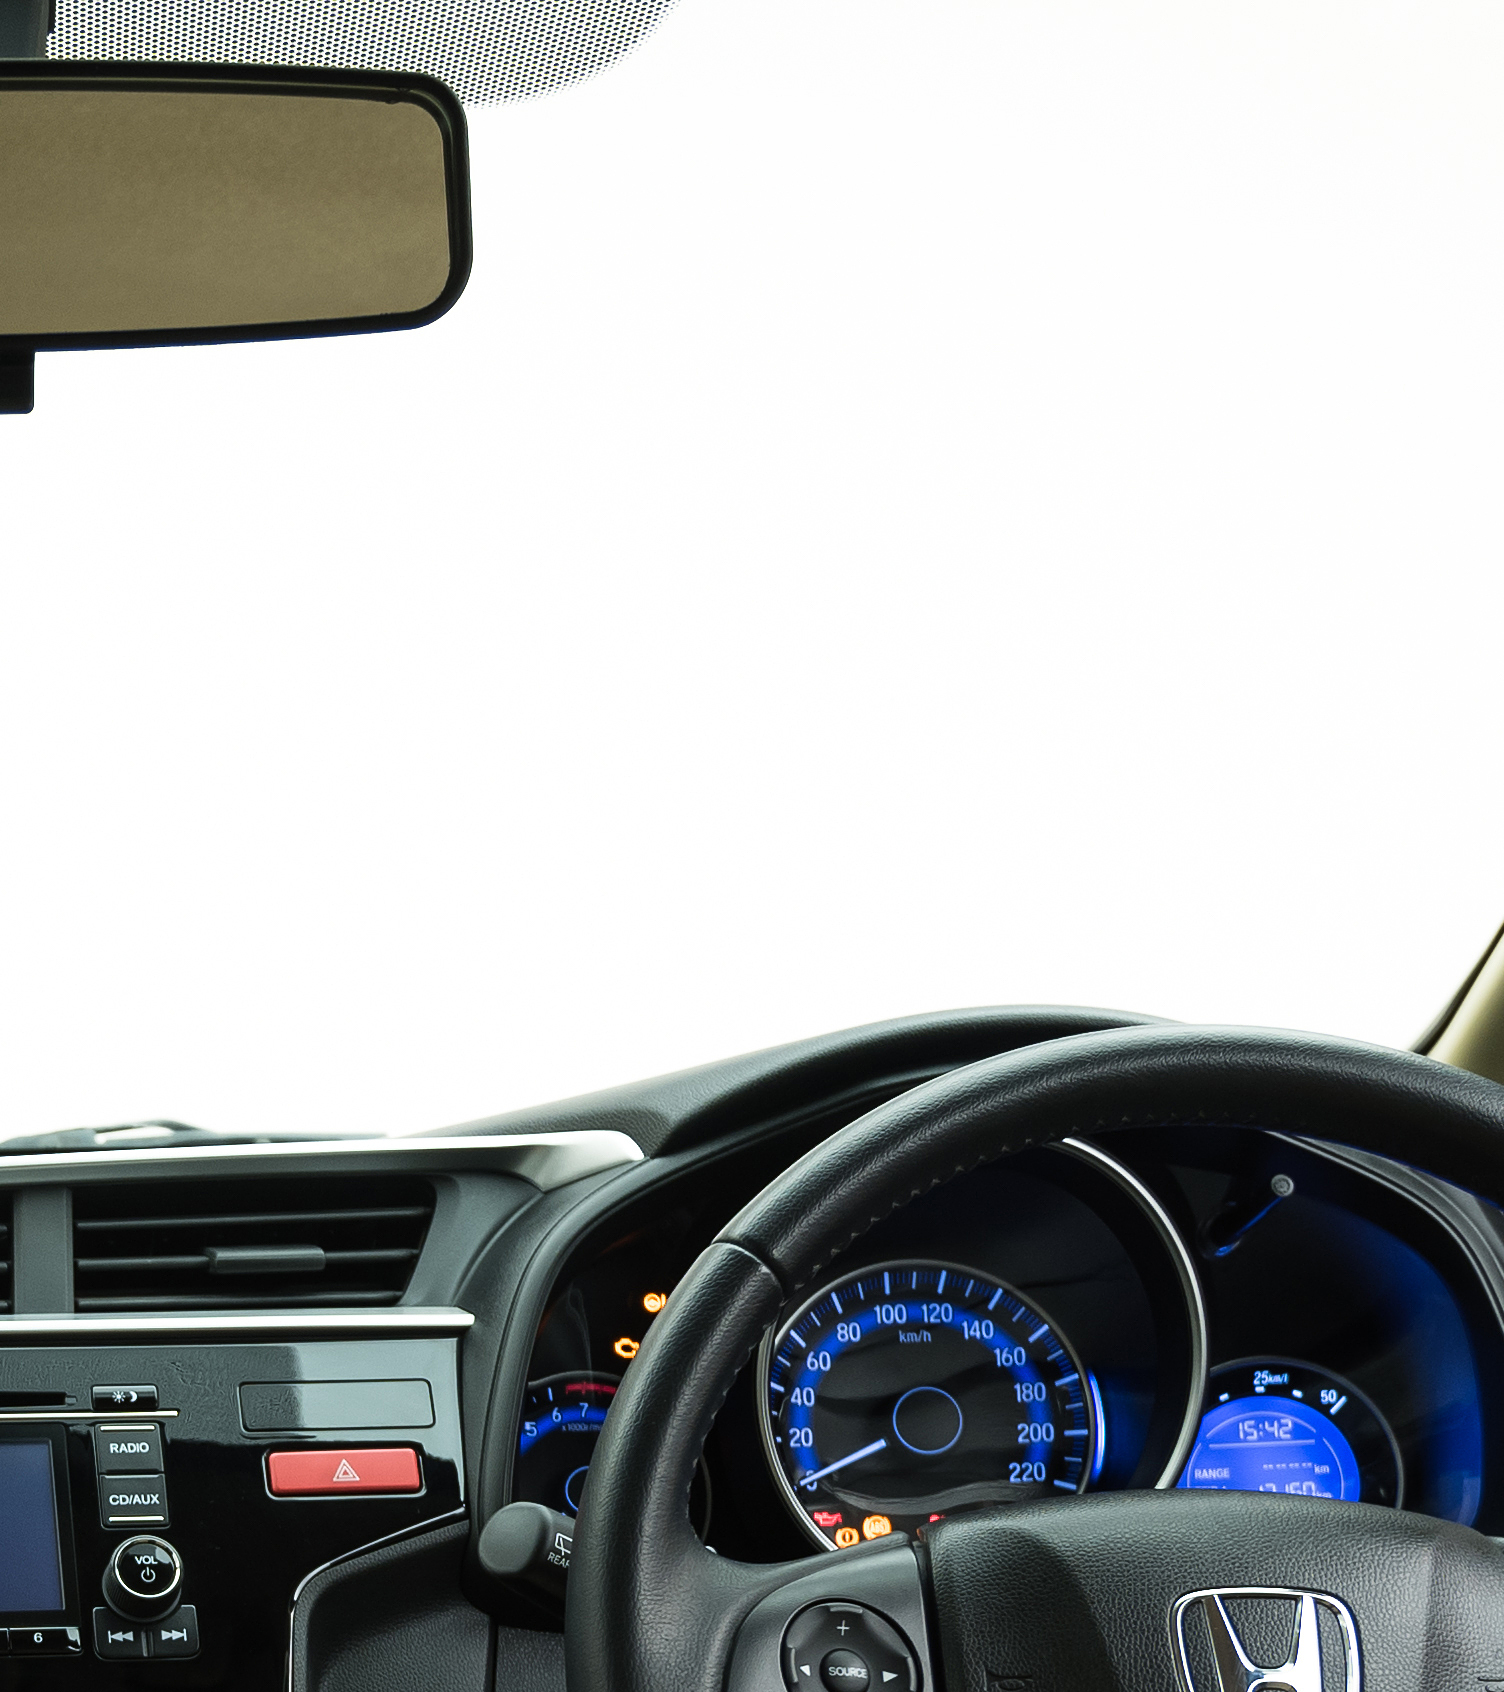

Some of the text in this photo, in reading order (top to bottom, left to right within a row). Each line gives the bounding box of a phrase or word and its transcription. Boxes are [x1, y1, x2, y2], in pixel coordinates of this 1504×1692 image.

[874, 1303, 952, 1324] 100 120
[836, 1322, 861, 1343] 80
[898, 1330, 932, 1343] km/h
[961, 1319, 994, 1340] 140
[806, 1351, 831, 1371] 60
[993, 1346, 1026, 1367] 160
[790, 1387, 815, 1407] 40
[1013, 1382, 1046, 1402] 180
[1320, 1390, 1337, 1403] 50
[551, 1408, 561, 1422] 6
[580, 1403, 588, 1417] 7
[525, 1422, 537, 1436] 5
[1017, 1423, 1054, 1443] 200
[1238, 1419, 1293, 1440] 15:42
[789, 1428, 814, 1448] 20
[109, 1442, 150, 1454] RADIO
[1008, 1462, 1046, 1483] 220
[1194, 1467, 1230, 1480] RANGE
[108, 1493, 160, 1506] CD/AUX
[134, 1555, 158, 1565] VOL
[33, 1632, 43, 1643] 6
[828, 1666, 868, 1679] SOURCE
